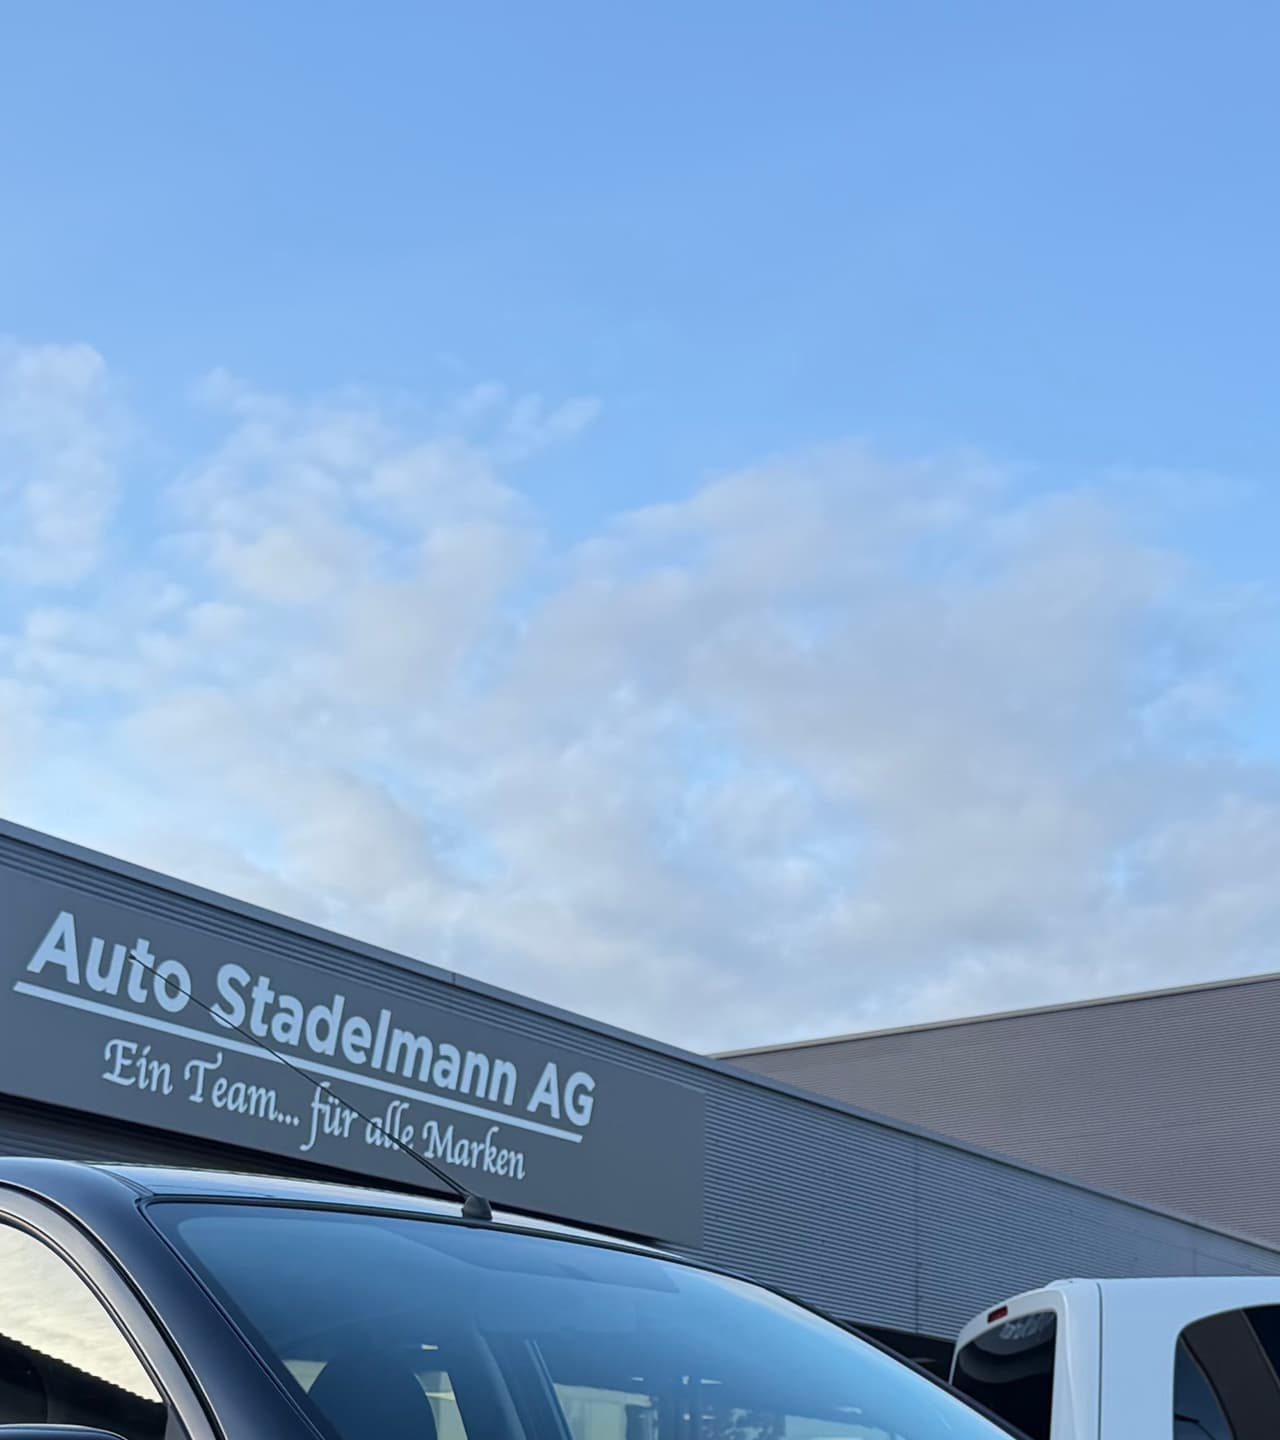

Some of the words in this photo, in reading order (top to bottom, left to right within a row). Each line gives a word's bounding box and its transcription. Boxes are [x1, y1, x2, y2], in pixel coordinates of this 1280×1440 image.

[26, 911, 192, 1013] Auto
[210, 963, 518, 1106] Stadelmann
[526, 1063, 595, 1127] AG
[101, 1038, 173, 1095] Ein
[300, 1080, 359, 1152] für
[363, 1101, 415, 1151] alle
[422, 1125, 527, 1180] Marken
